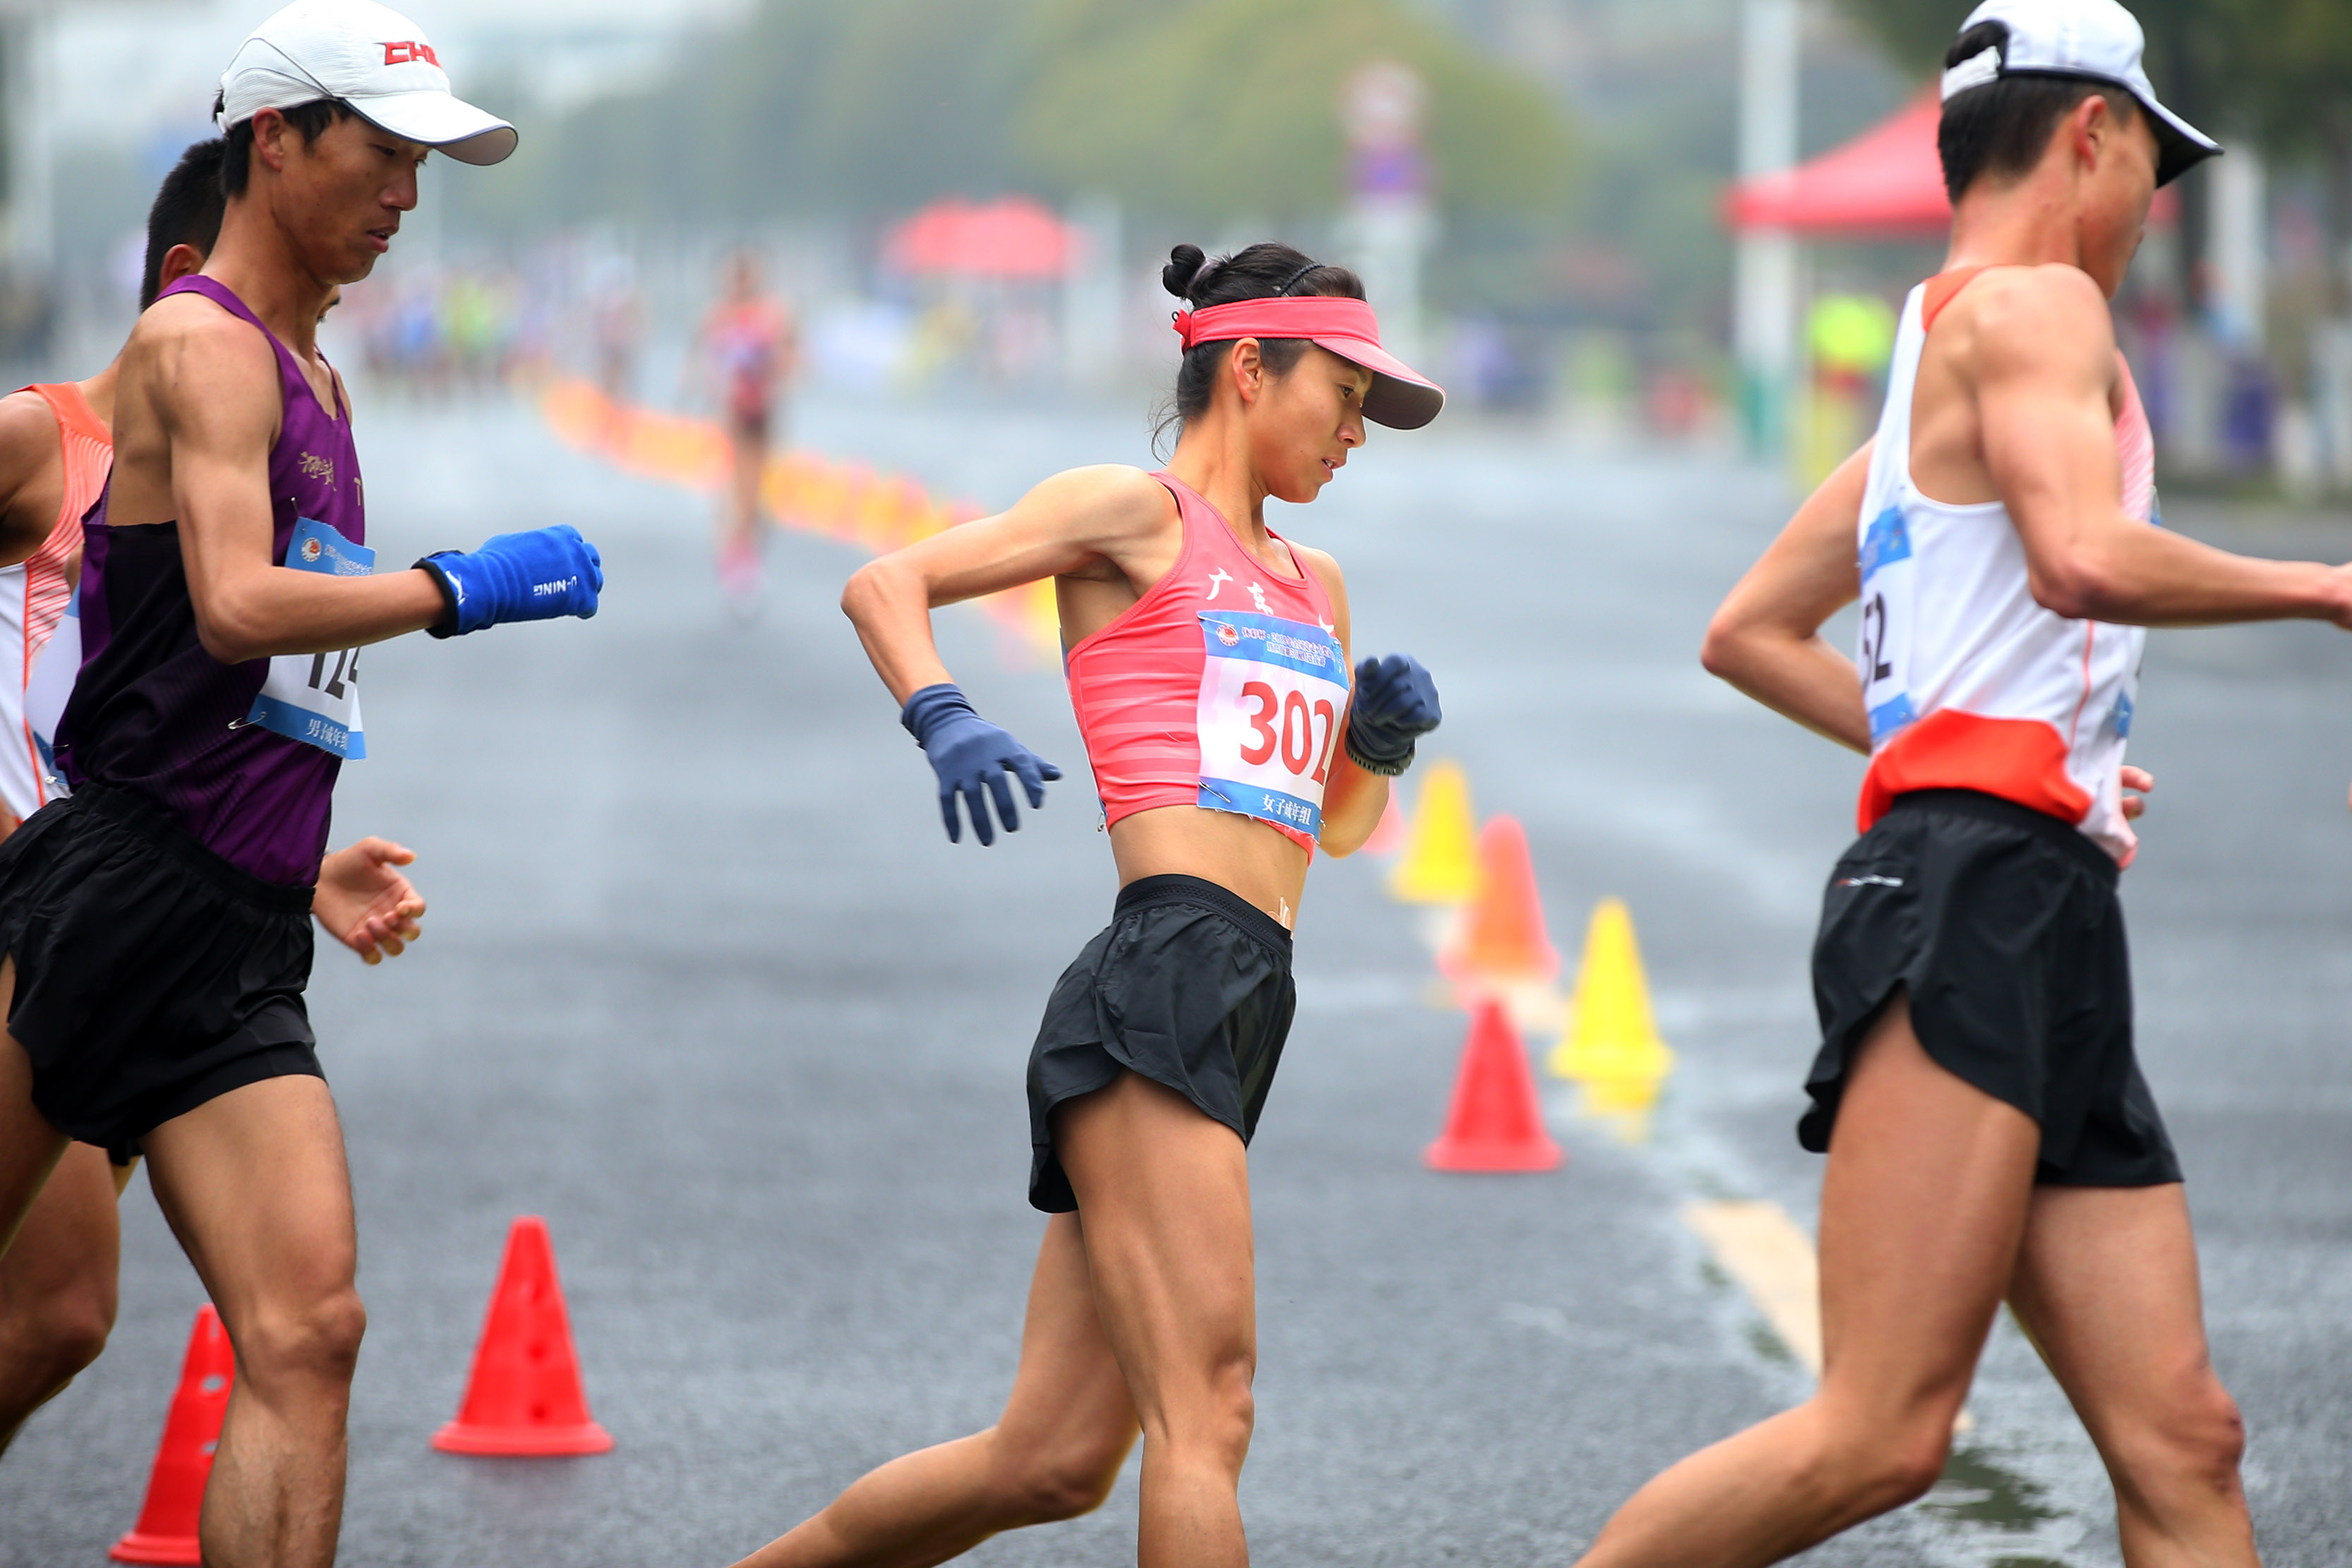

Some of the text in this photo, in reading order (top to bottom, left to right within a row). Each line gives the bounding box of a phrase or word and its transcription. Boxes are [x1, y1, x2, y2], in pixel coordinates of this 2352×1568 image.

[1241, 680, 1334, 788] 302
[1261, 793, 1312, 826] 女子成年组
